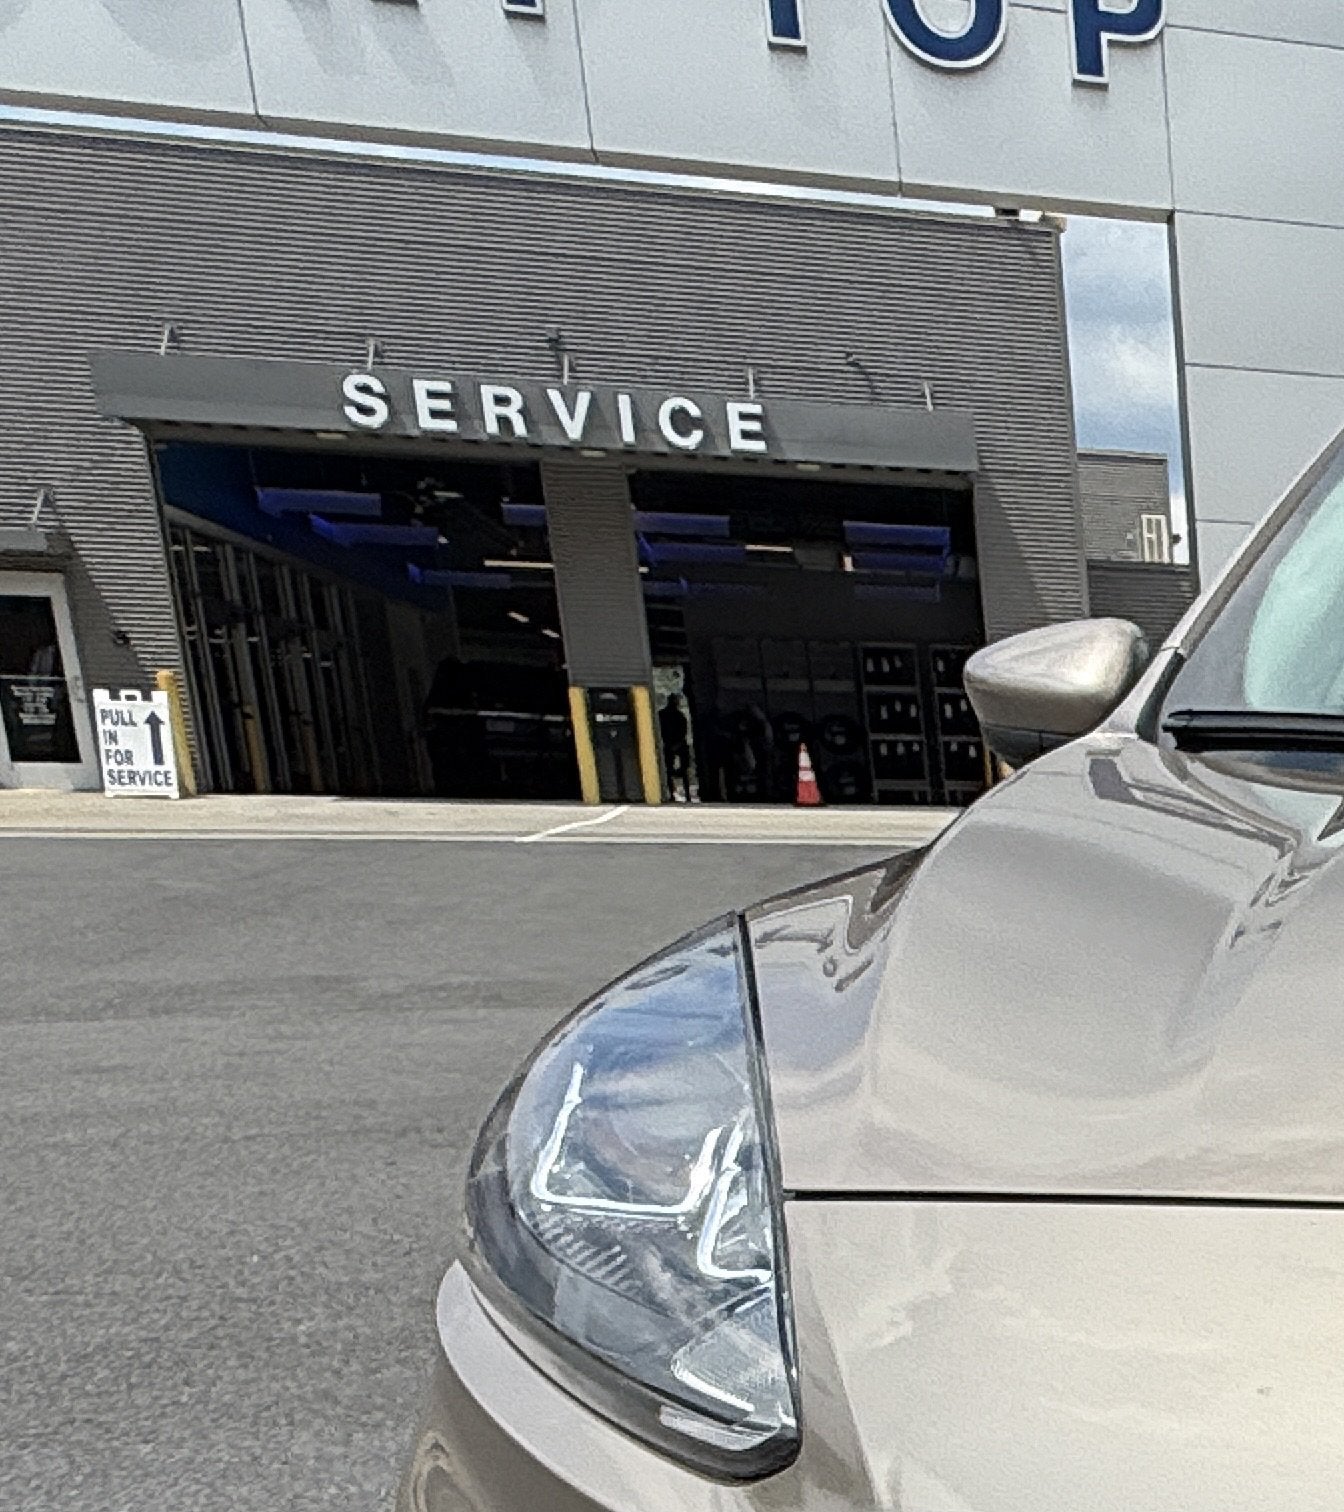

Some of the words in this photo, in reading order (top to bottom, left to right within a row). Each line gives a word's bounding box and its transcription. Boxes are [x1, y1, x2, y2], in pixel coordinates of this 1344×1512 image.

[341, 372, 769, 453] SERVICE
[99, 708, 138, 727] PULL
[102, 728, 119, 746] IN
[104, 748, 134, 766] FOR
[106, 768, 174, 787] SERVICE
